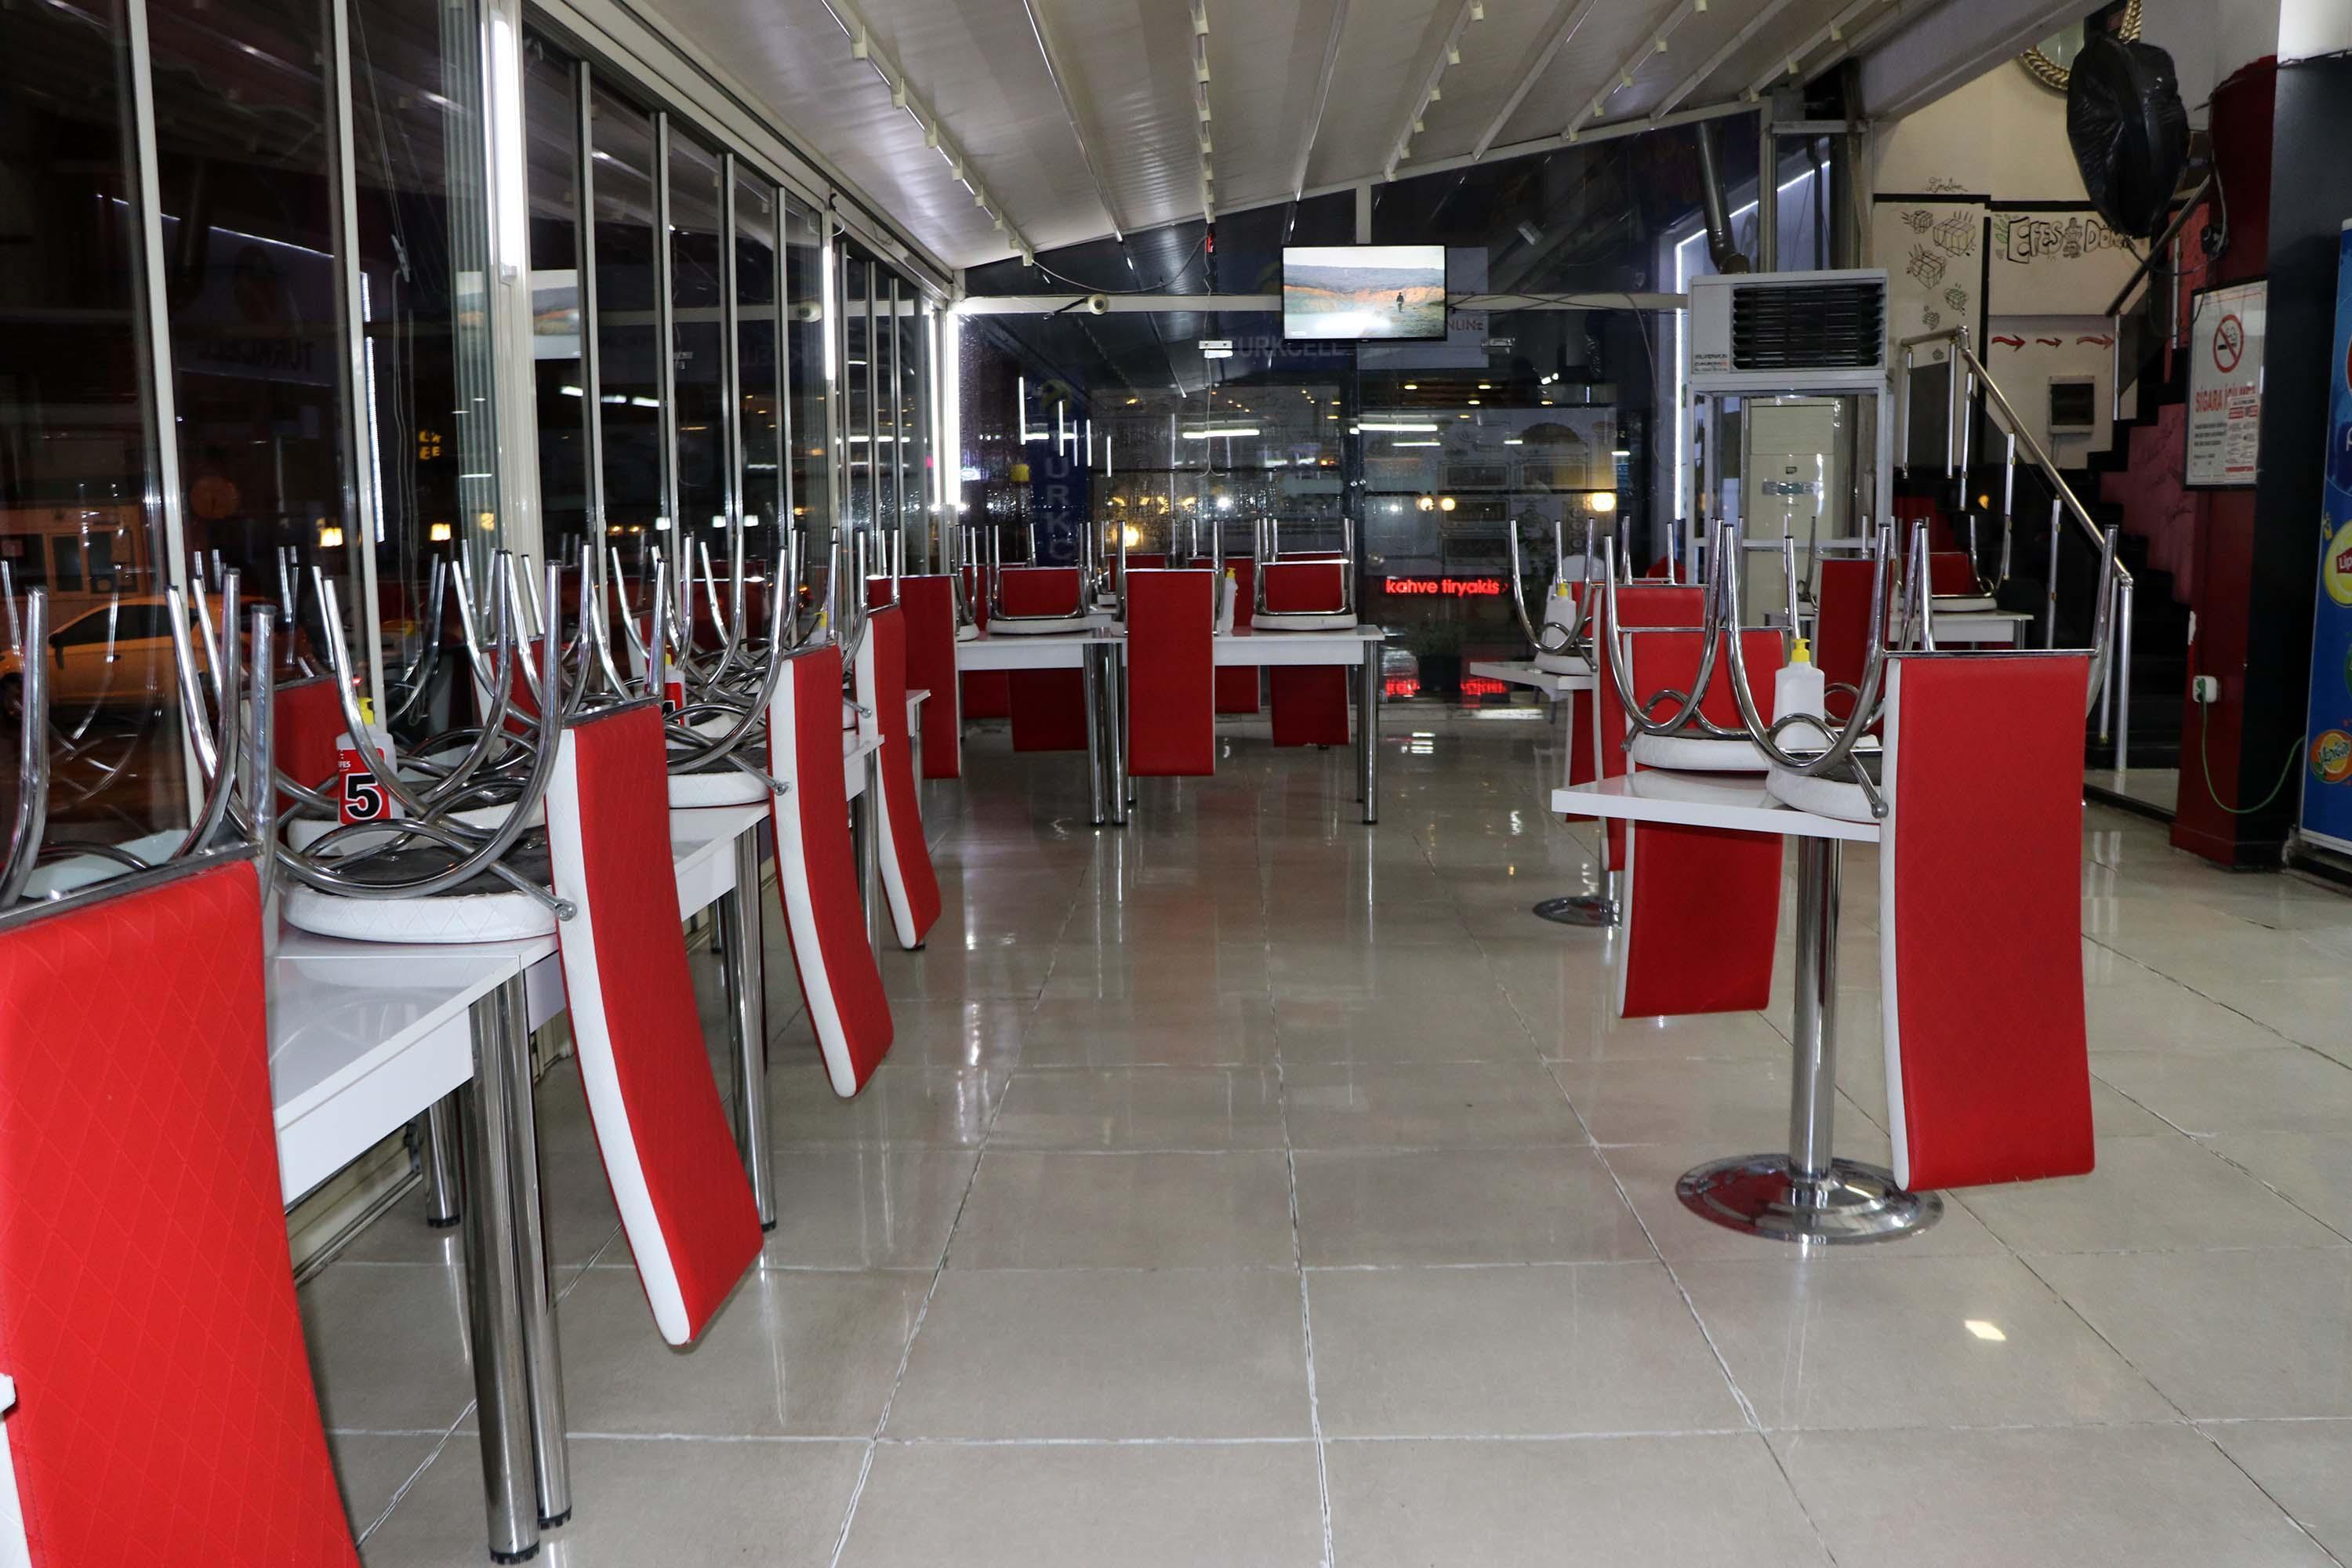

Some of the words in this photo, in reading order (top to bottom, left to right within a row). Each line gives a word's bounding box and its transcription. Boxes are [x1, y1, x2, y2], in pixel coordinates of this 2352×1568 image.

[2006, 216, 2066, 263] EFES
[1231, 336, 1344, 357] URKCELL
[1385, 578, 1438, 594] kahve
[345, 772, 383, 820] 5
